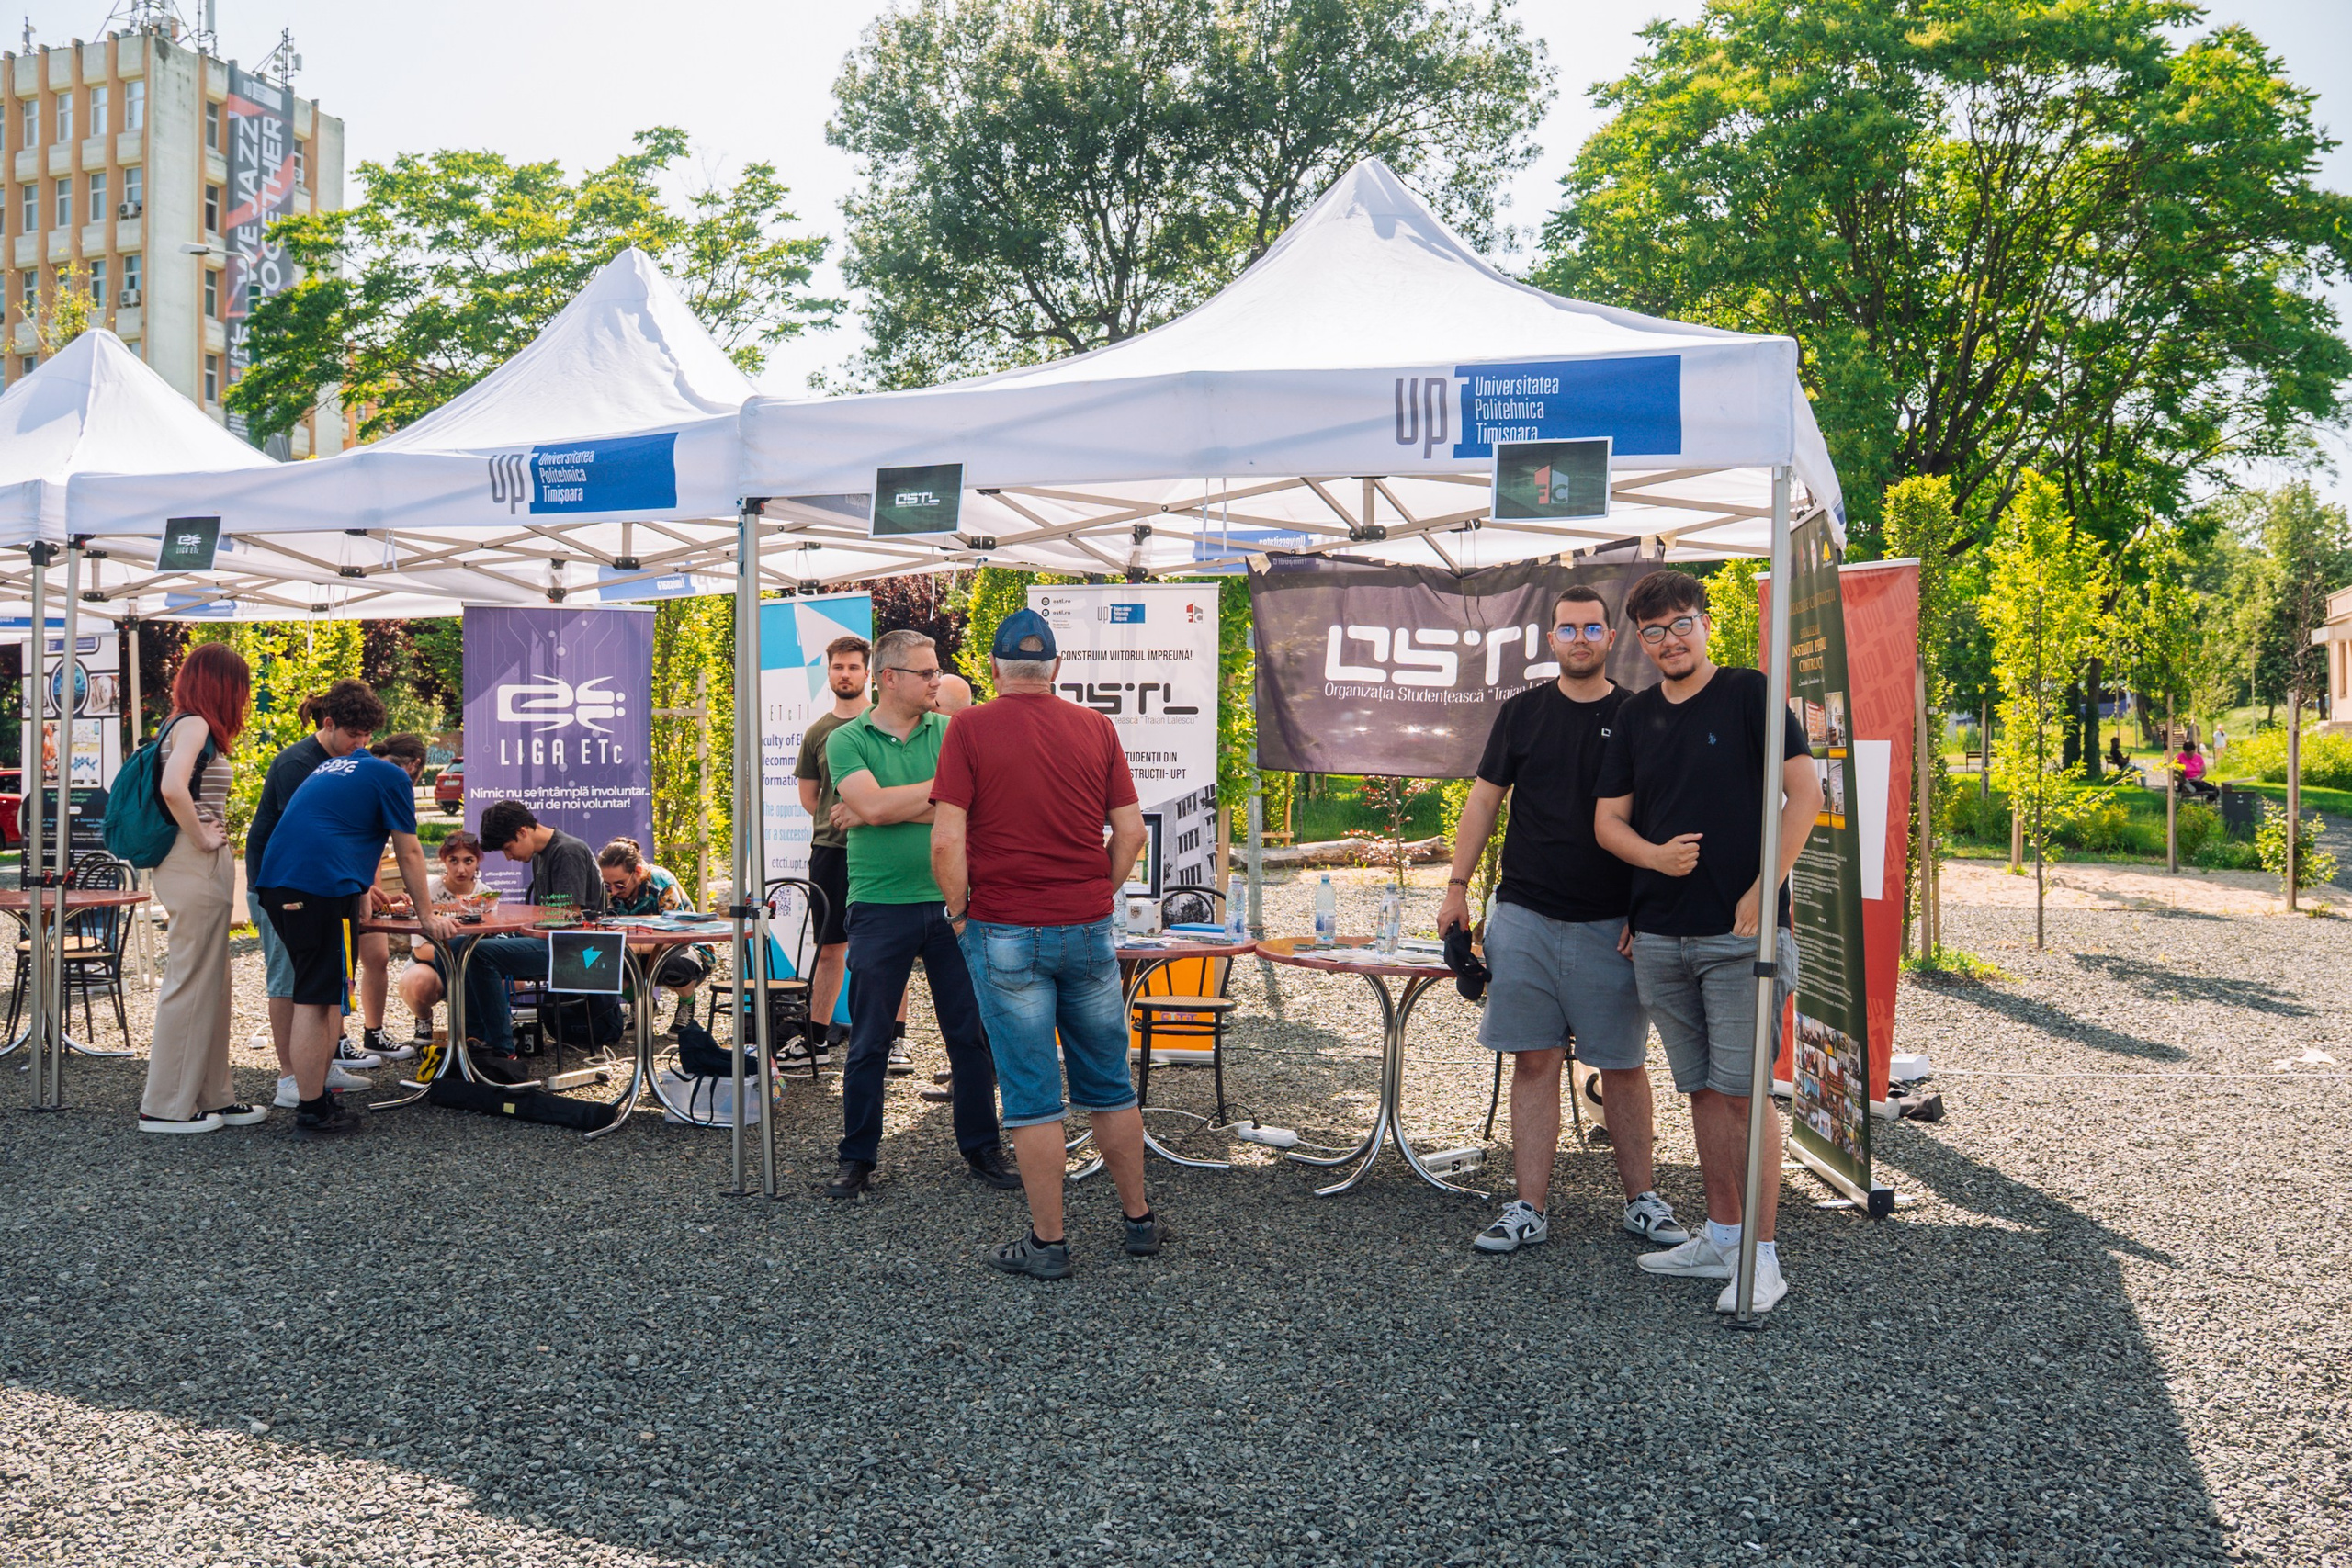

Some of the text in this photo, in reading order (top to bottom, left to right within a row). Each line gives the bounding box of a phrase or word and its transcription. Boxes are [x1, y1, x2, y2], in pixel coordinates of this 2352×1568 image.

[237, 116, 259, 284] WE JAZZ
[1475, 374, 1560, 397] Universitatea
[1475, 397, 1544, 421] Politehnica
[538, 450, 595, 466] Universitatea
[538, 467, 587, 483] Politehnica
[543, 486, 583, 505] Timișoara
[1060, 648, 1193, 661] CONSTRUIM VIITORUL ÎMPREUNĂ!
[1324, 682, 1394, 701] Organizația
[1397, 687, 1485, 705] Studențească
[786, 733, 795, 746] of
[501, 739, 566, 765] LIGA
[1125, 751, 1177, 764] TUDENȚII DIN
[1170, 769, 1186, 779] UPT
[470, 787, 505, 798] Nimic
[506, 790, 523, 798] nu
[524, 789, 537, 798] se
[538, 786, 589, 800] întâmplă
[546, 798, 561, 810] de
[562, 798, 581, 809] noi
[582, 797, 631, 809] voluntar!
[774, 829, 778, 840] a
